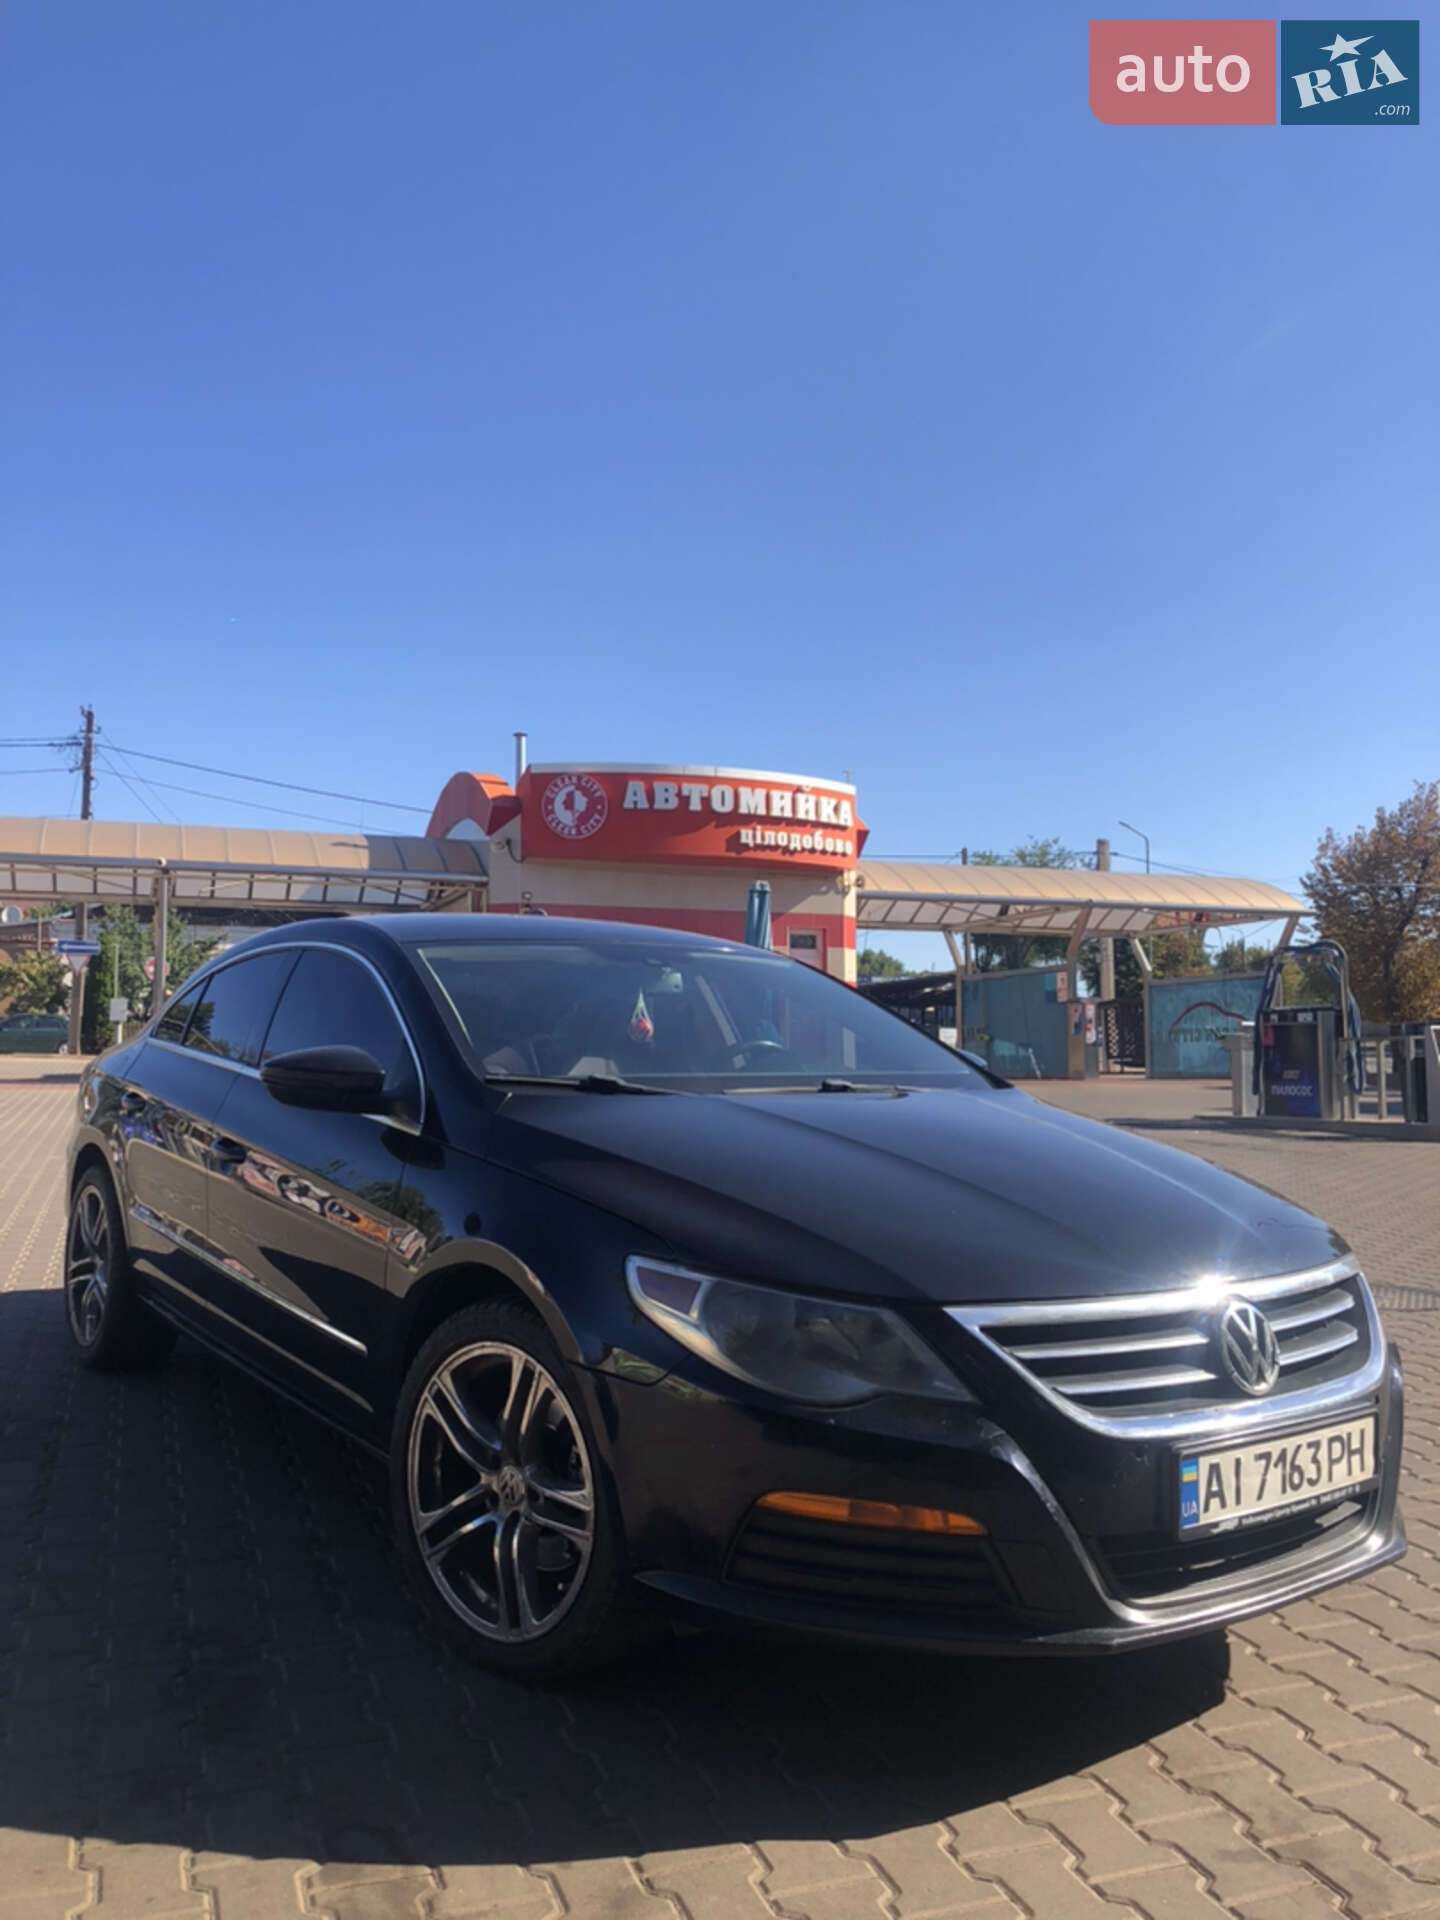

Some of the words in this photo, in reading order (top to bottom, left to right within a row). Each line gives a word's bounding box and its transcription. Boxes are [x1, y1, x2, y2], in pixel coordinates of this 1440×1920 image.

[623, 781, 854, 828] АВТОМИЙКА
[740, 826, 854, 856] цілодобово
[1181, 1501, 1199, 1517] UA
